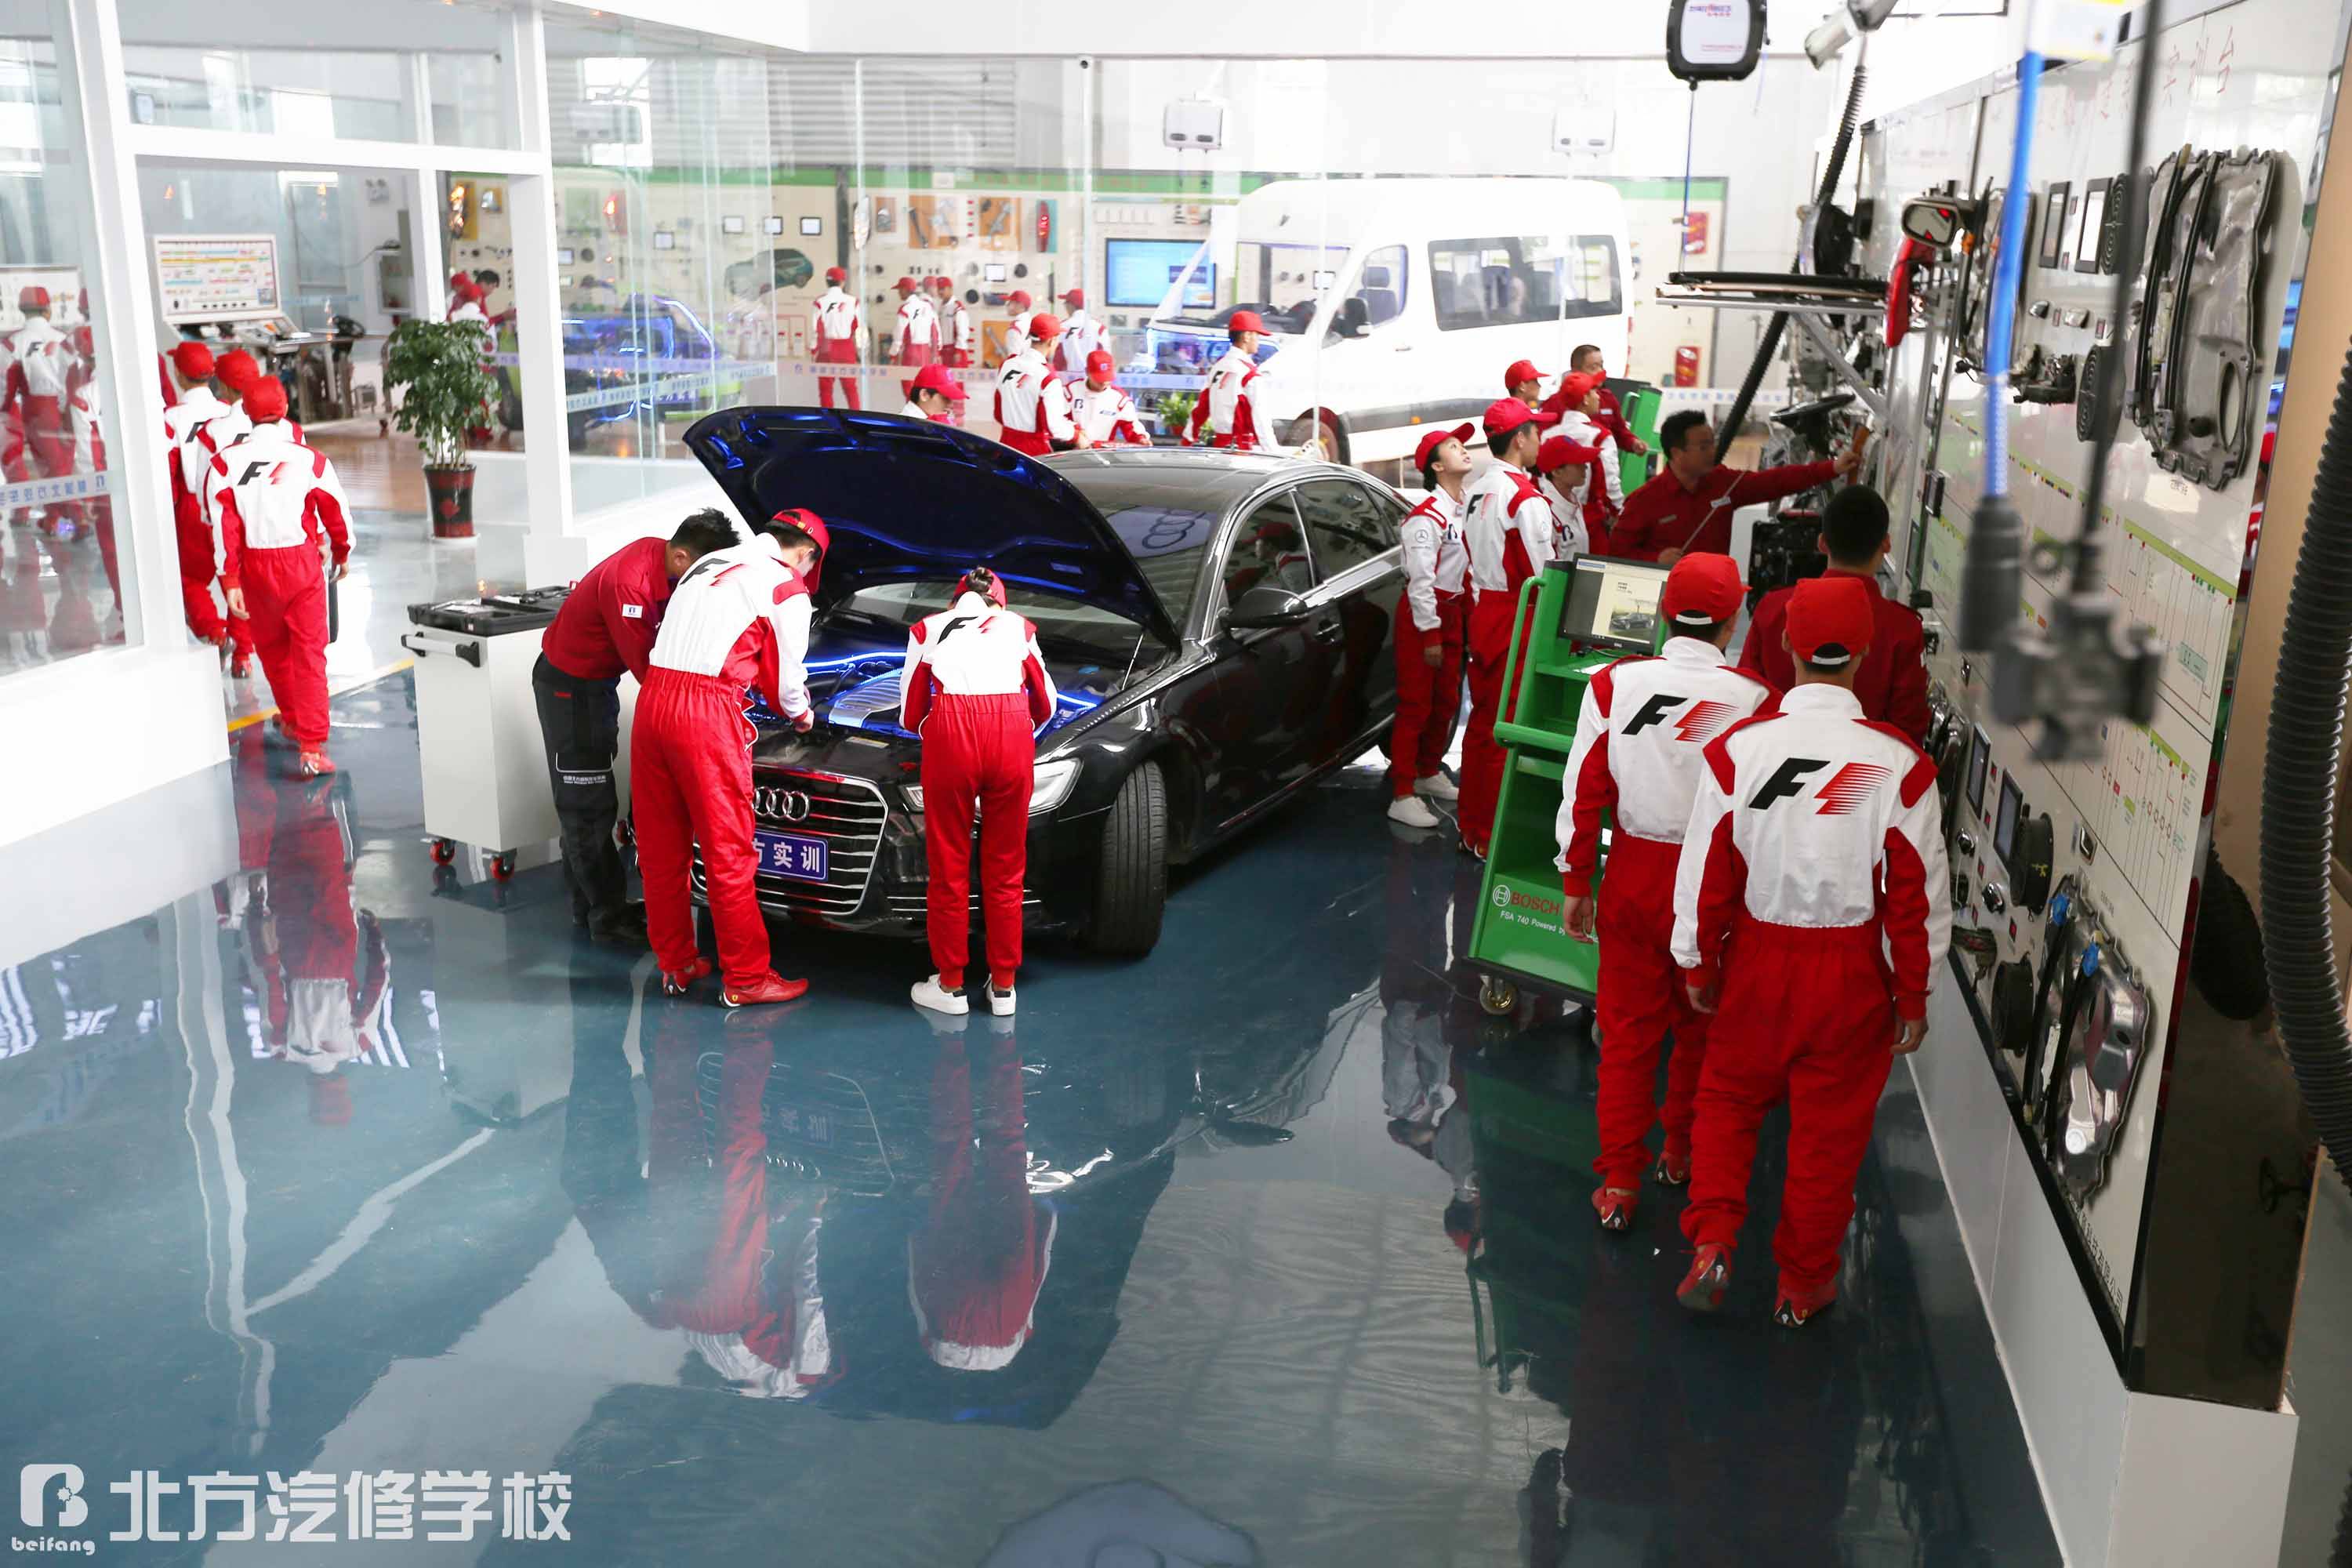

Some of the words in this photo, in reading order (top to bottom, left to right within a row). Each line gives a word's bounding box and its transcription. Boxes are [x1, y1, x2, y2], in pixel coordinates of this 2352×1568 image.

[1621, 693, 1740, 743] F1
[1748, 757, 1894, 815] F1
[1500, 909, 1515, 922] FSA
[1517, 914, 1530, 926] 740
[1531, 918, 1556, 933] Powered
[1511, 891, 1560, 915] BOSCH
